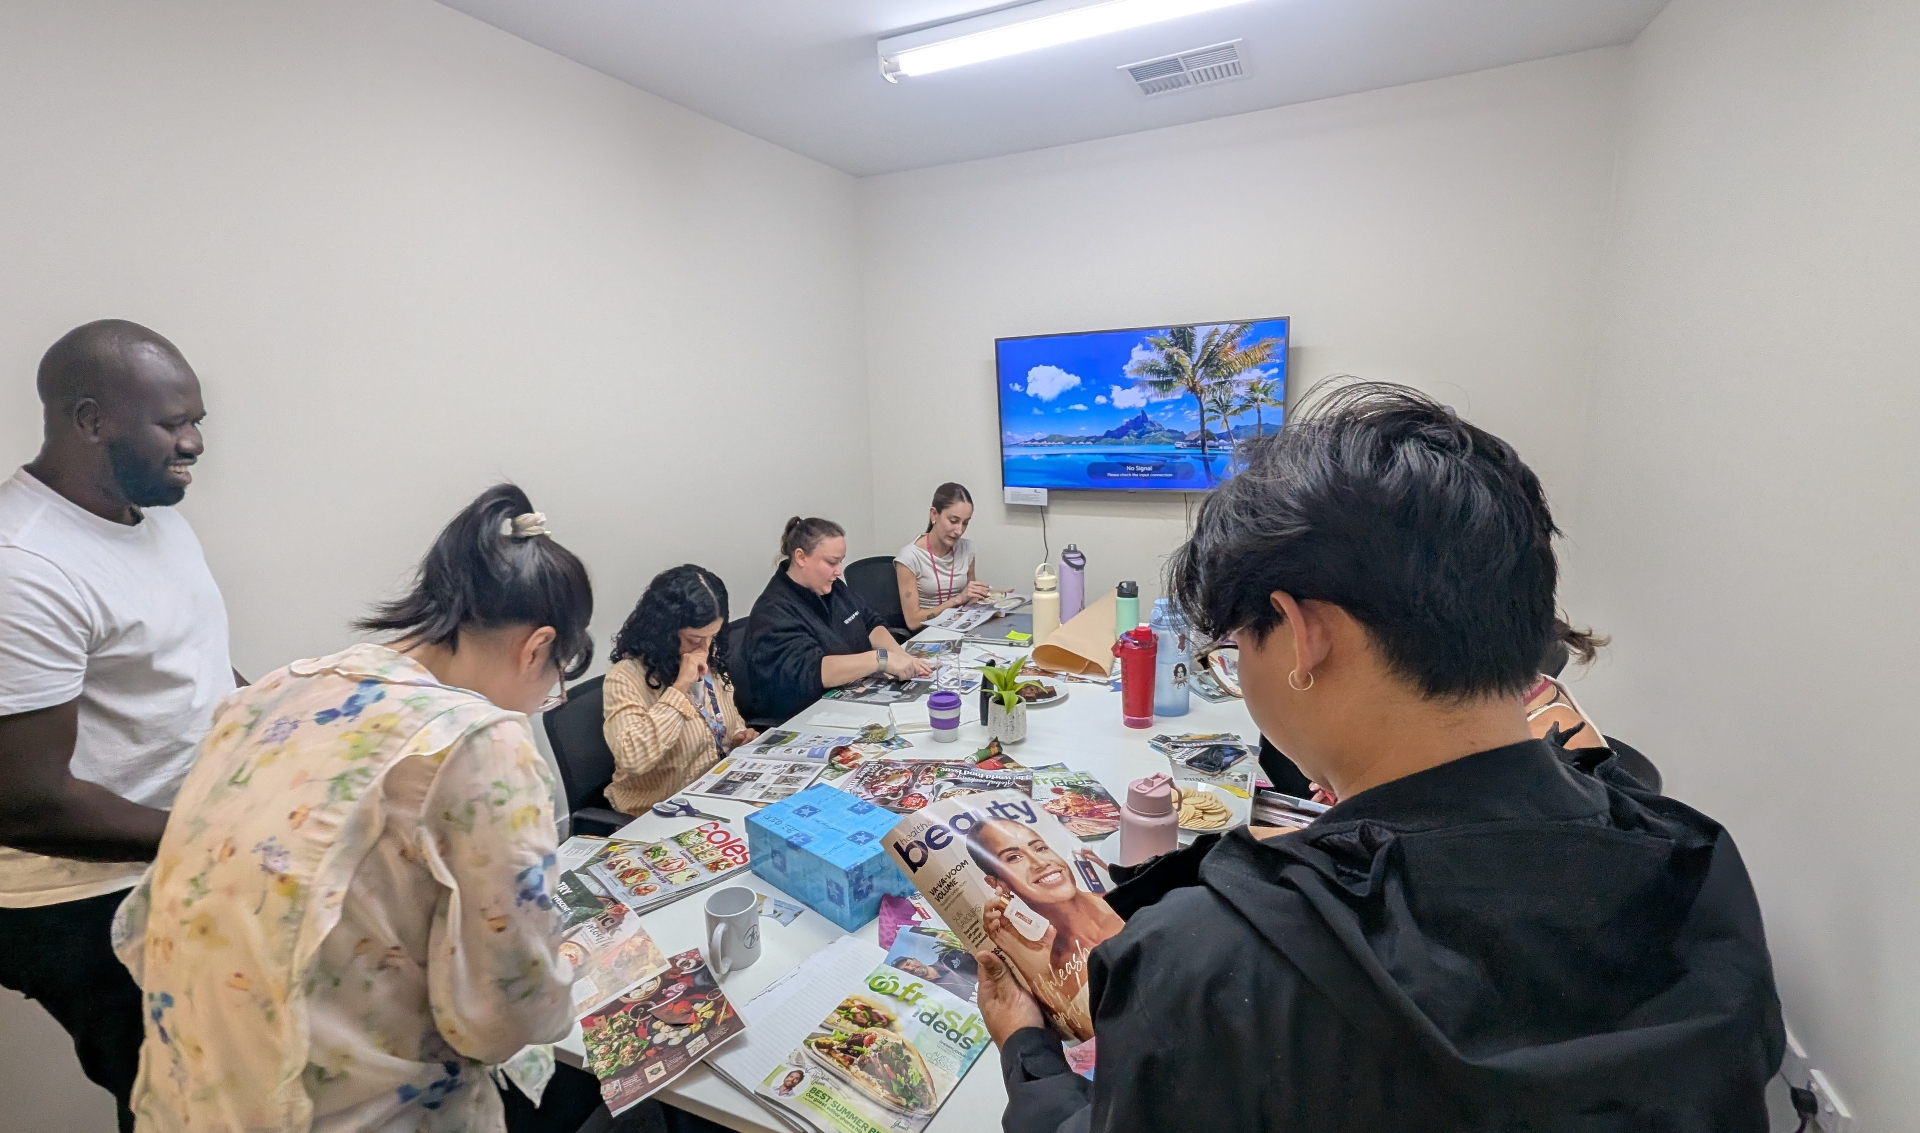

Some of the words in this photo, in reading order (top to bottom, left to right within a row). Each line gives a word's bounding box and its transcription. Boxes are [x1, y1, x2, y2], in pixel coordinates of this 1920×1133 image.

[1033, 772, 1093, 786] fresh
[1051, 779, 1094, 787] ideas
[695, 821, 750, 865] coles
[893, 800, 1038, 875] beauty
[929, 859, 969, 896] VA-VA-VOOM
[934, 877, 959, 902] VOLUME
[897, 982, 984, 1046] fresh
[912, 1006, 975, 1050] ideas
[805, 1092, 815, 1100] Our
[813, 1096, 827, 1108] guest
[826, 1105, 840, 1118] editor
[839, 1115, 856, 1130] shares
[809, 1086, 833, 1103] BEST
[830, 1099, 870, 1132] SUMMER
